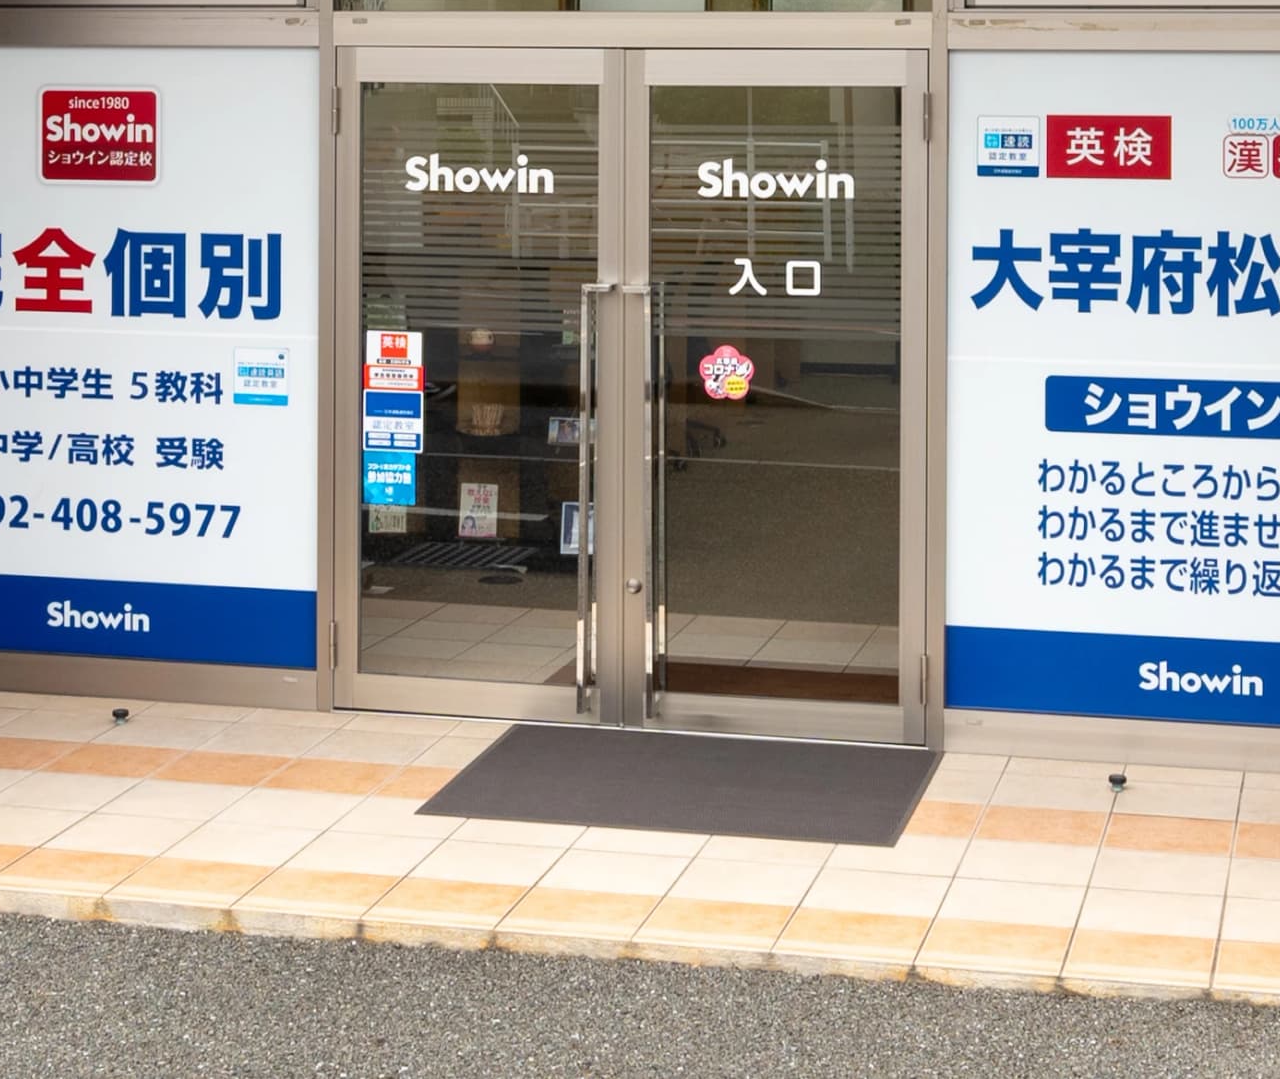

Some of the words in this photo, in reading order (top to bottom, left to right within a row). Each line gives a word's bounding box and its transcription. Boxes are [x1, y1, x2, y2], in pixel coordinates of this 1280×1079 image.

[68, 96, 129, 110] since1980
[45, 113, 153, 144] Showin
[48, 150, 153, 167] ショウイン認定校
[1066, 127, 1153, 168] 英検
[404, 152, 554, 194] Showin
[696, 157, 855, 200] Showin
[728, 257, 821, 297] 入口
[155, 436, 225, 471] 受験
[46, 600, 150, 632] Showin
[1138, 660, 1264, 697] Showin
